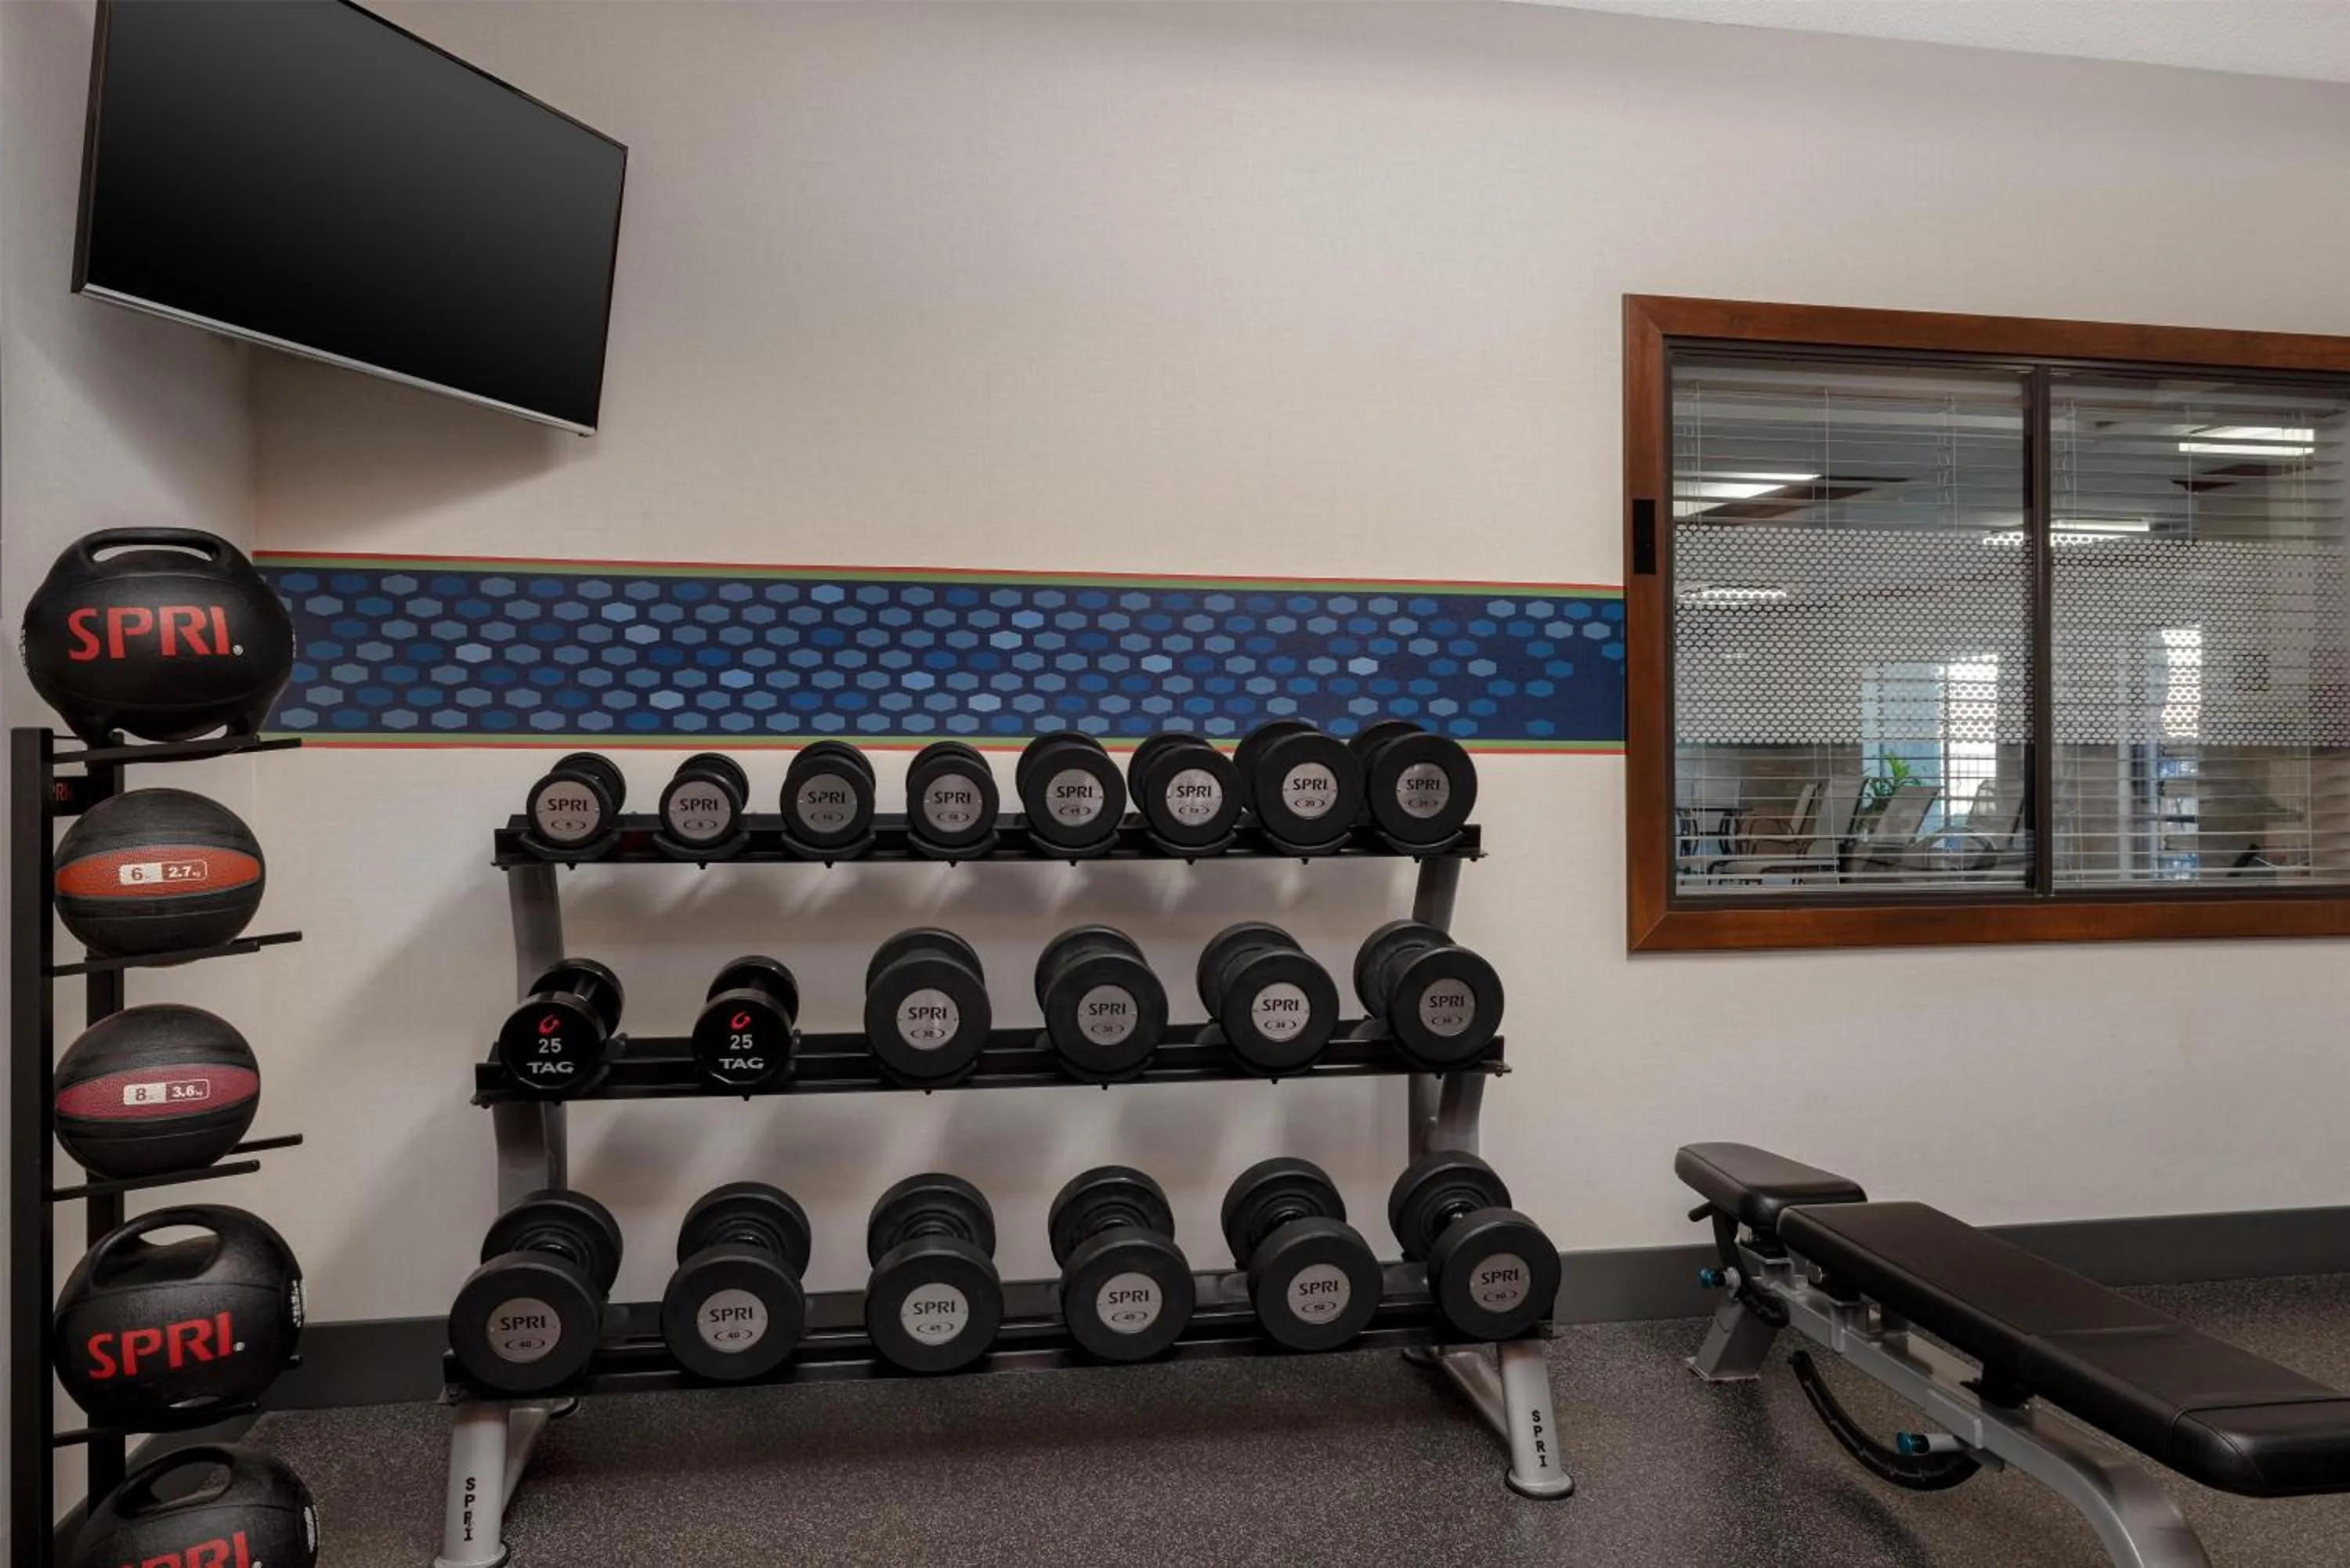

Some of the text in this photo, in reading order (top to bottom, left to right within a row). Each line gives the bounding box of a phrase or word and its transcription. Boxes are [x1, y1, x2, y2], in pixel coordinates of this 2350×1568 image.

[67, 605, 231, 661] SPRI
[1292, 778, 1329, 791] SPRI
[1405, 779, 1441, 791] SPRI
[807, 791, 845, 804] SPRI
[933, 791, 971, 804] SPRI
[1055, 785, 1094, 799] SPRI
[1177, 786, 1213, 798] SPRI
[548, 798, 588, 812] SPRI
[679, 797, 718, 811] SPRI
[131, 867, 143, 881] 6
[168, 865, 192, 878] 2.7
[1261, 998, 1300, 1012] SPRI
[1429, 995, 1466, 1009] SPRI
[908, 1006, 948, 1021] SPRI
[1088, 1003, 1127, 1016] SPRI
[538, 1037, 562, 1054] 25
[729, 1033, 754, 1050] 25
[526, 1060, 575, 1074] TAG
[718, 1057, 765, 1070] TAG
[135, 1087, 146, 1101] 8
[172, 1084, 195, 1097] 3.6
[1480, 1267, 1520, 1286] SPRI
[1298, 1279, 1340, 1296] SPRI
[1108, 1289, 1150, 1305] SPRI
[708, 1305, 754, 1323] SPRI
[913, 1299, 956, 1316] SPRI
[500, 1314, 547, 1331] SPRI
[86, 1310, 233, 1380] SPRI
[1531, 1409, 1548, 1468] SPRI
[463, 1476, 477, 1542] SPRI
